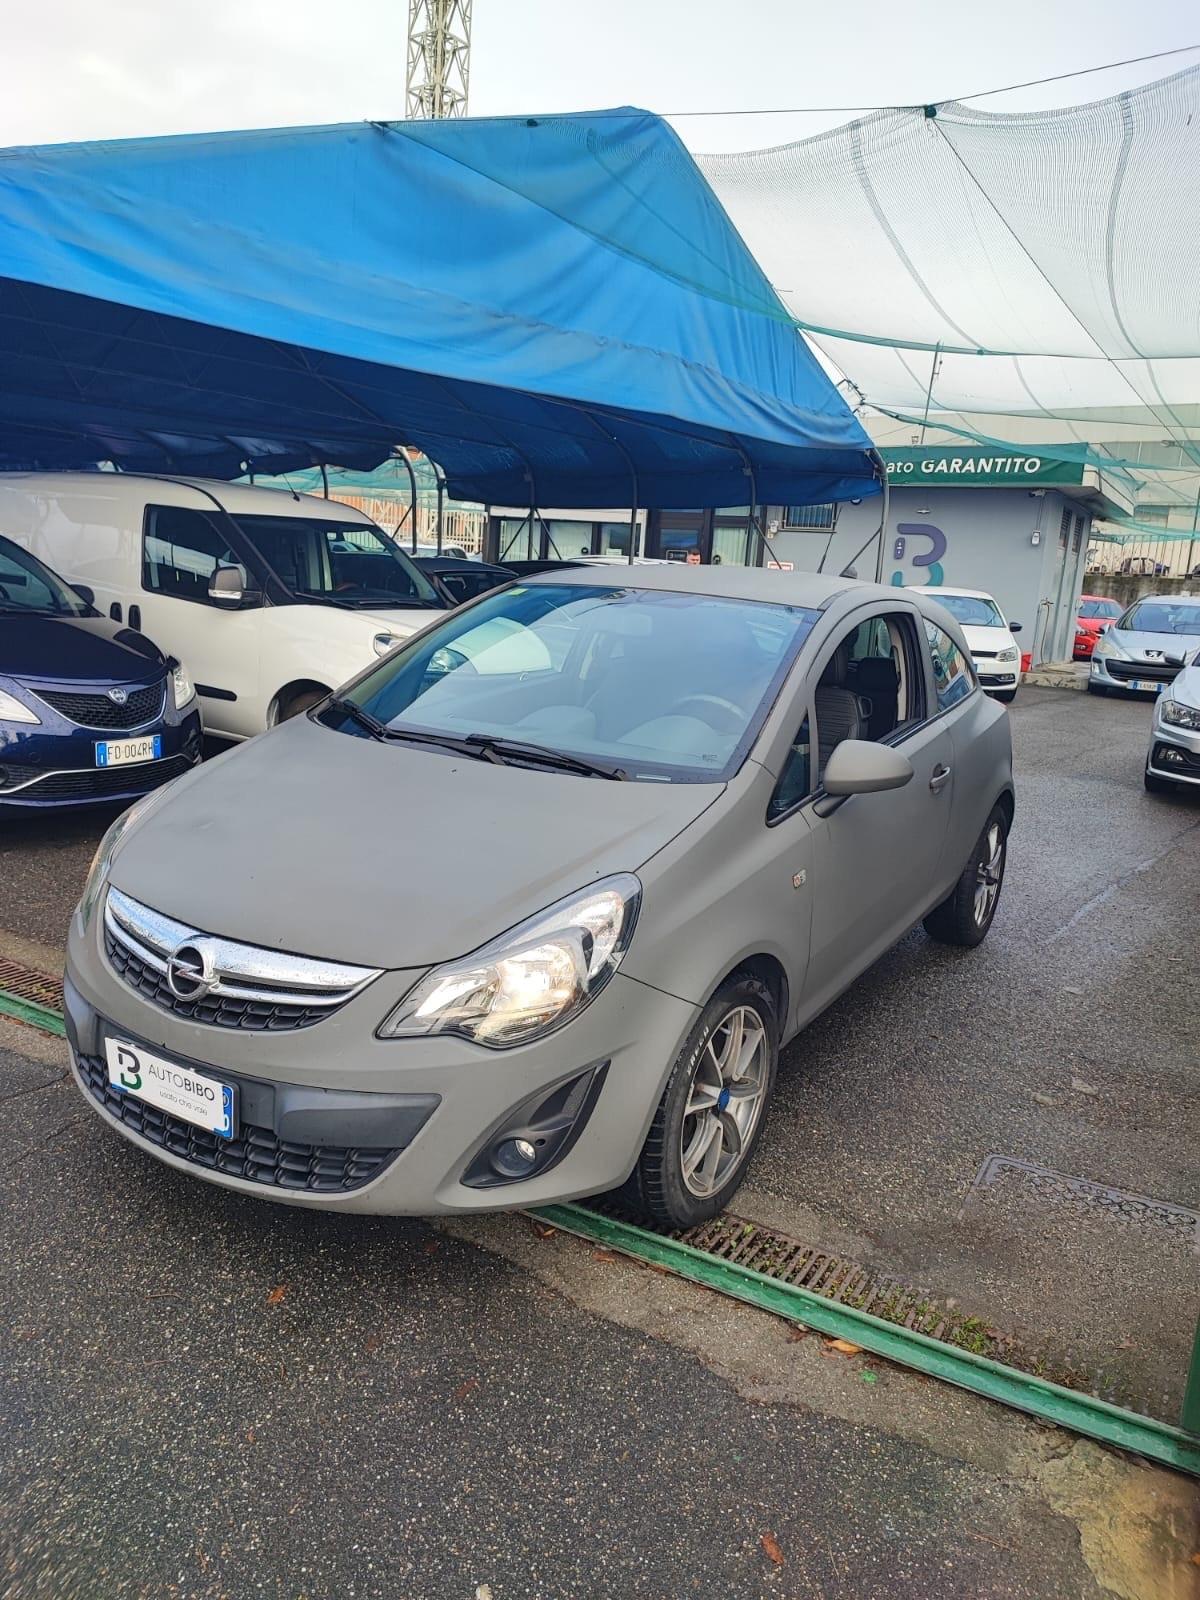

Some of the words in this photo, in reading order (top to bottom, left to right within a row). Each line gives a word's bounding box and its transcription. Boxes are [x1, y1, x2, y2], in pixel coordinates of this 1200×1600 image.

[921, 457, 1041, 474] GARANTITO
[107, 745, 121, 760] FD
[148, 1064, 215, 1101] AUTOBIBO
